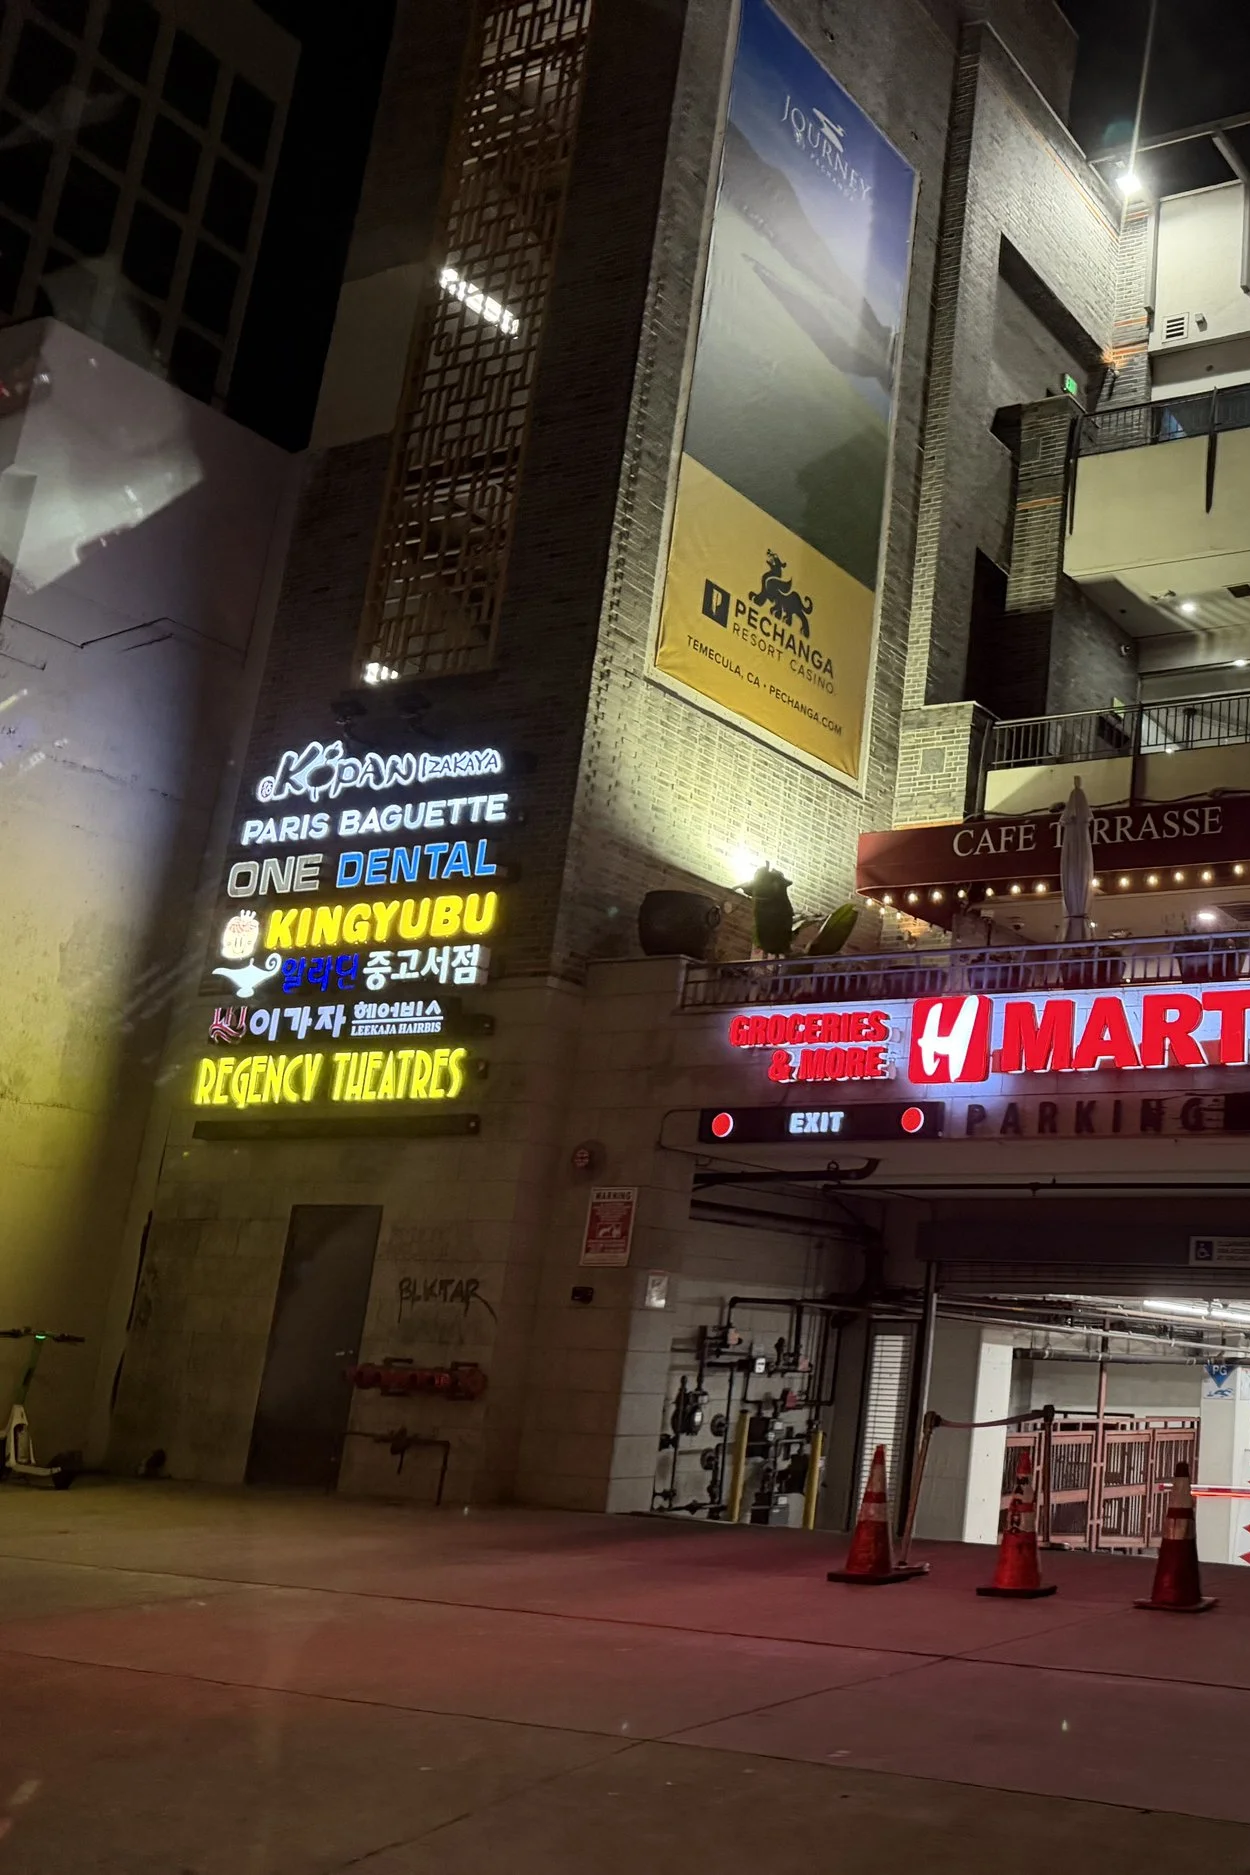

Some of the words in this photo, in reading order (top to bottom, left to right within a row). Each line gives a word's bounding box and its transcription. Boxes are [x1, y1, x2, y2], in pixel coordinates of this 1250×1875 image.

[781, 95, 872, 201] JOURNEY
[732, 622, 784, 662] RESORT
[790, 659, 835, 695] CASINO
[735, 599, 835, 680] PECHANGA
[687, 634, 744, 679] TEMECULA,
[747, 672, 761, 689] CA
[769, 684, 843, 736] PECHANGA.COM
[418, 748, 503, 783] IZAKAYA
[241, 812, 330, 846] PARIS
[339, 793, 509, 836] BAGUETTE
[952, 818, 1038, 859] CAFÉ
[1049, 806, 1224, 850] TRRASSE
[227, 853, 324, 898] ONE
[335, 838, 498, 888] DENTAL
[263, 890, 498, 949] KINGYUBU
[281, 952, 359, 994] 알라딘
[363, 943, 481, 991] 중고서점
[249, 1003, 347, 1042] 이가자
[353, 999, 442, 1019] 헤어비스
[350, 1023, 397, 1037] LEEKAJA
[398, 1021, 442, 1034] HAIRBIS
[729, 1010, 889, 1048] GROCERIES
[195, 1052, 323, 1109] REGENCY
[333, 1048, 467, 1100] THEATRES
[768, 1049, 794, 1082] &
[797, 1045, 887, 1081] MORE
[788, 1111, 845, 1134] EXIT
[966, 1097, 1205, 1137] PARKING
[595, 1191, 632, 1200] WARNING
[1212, 1365, 1227, 1376] PG
